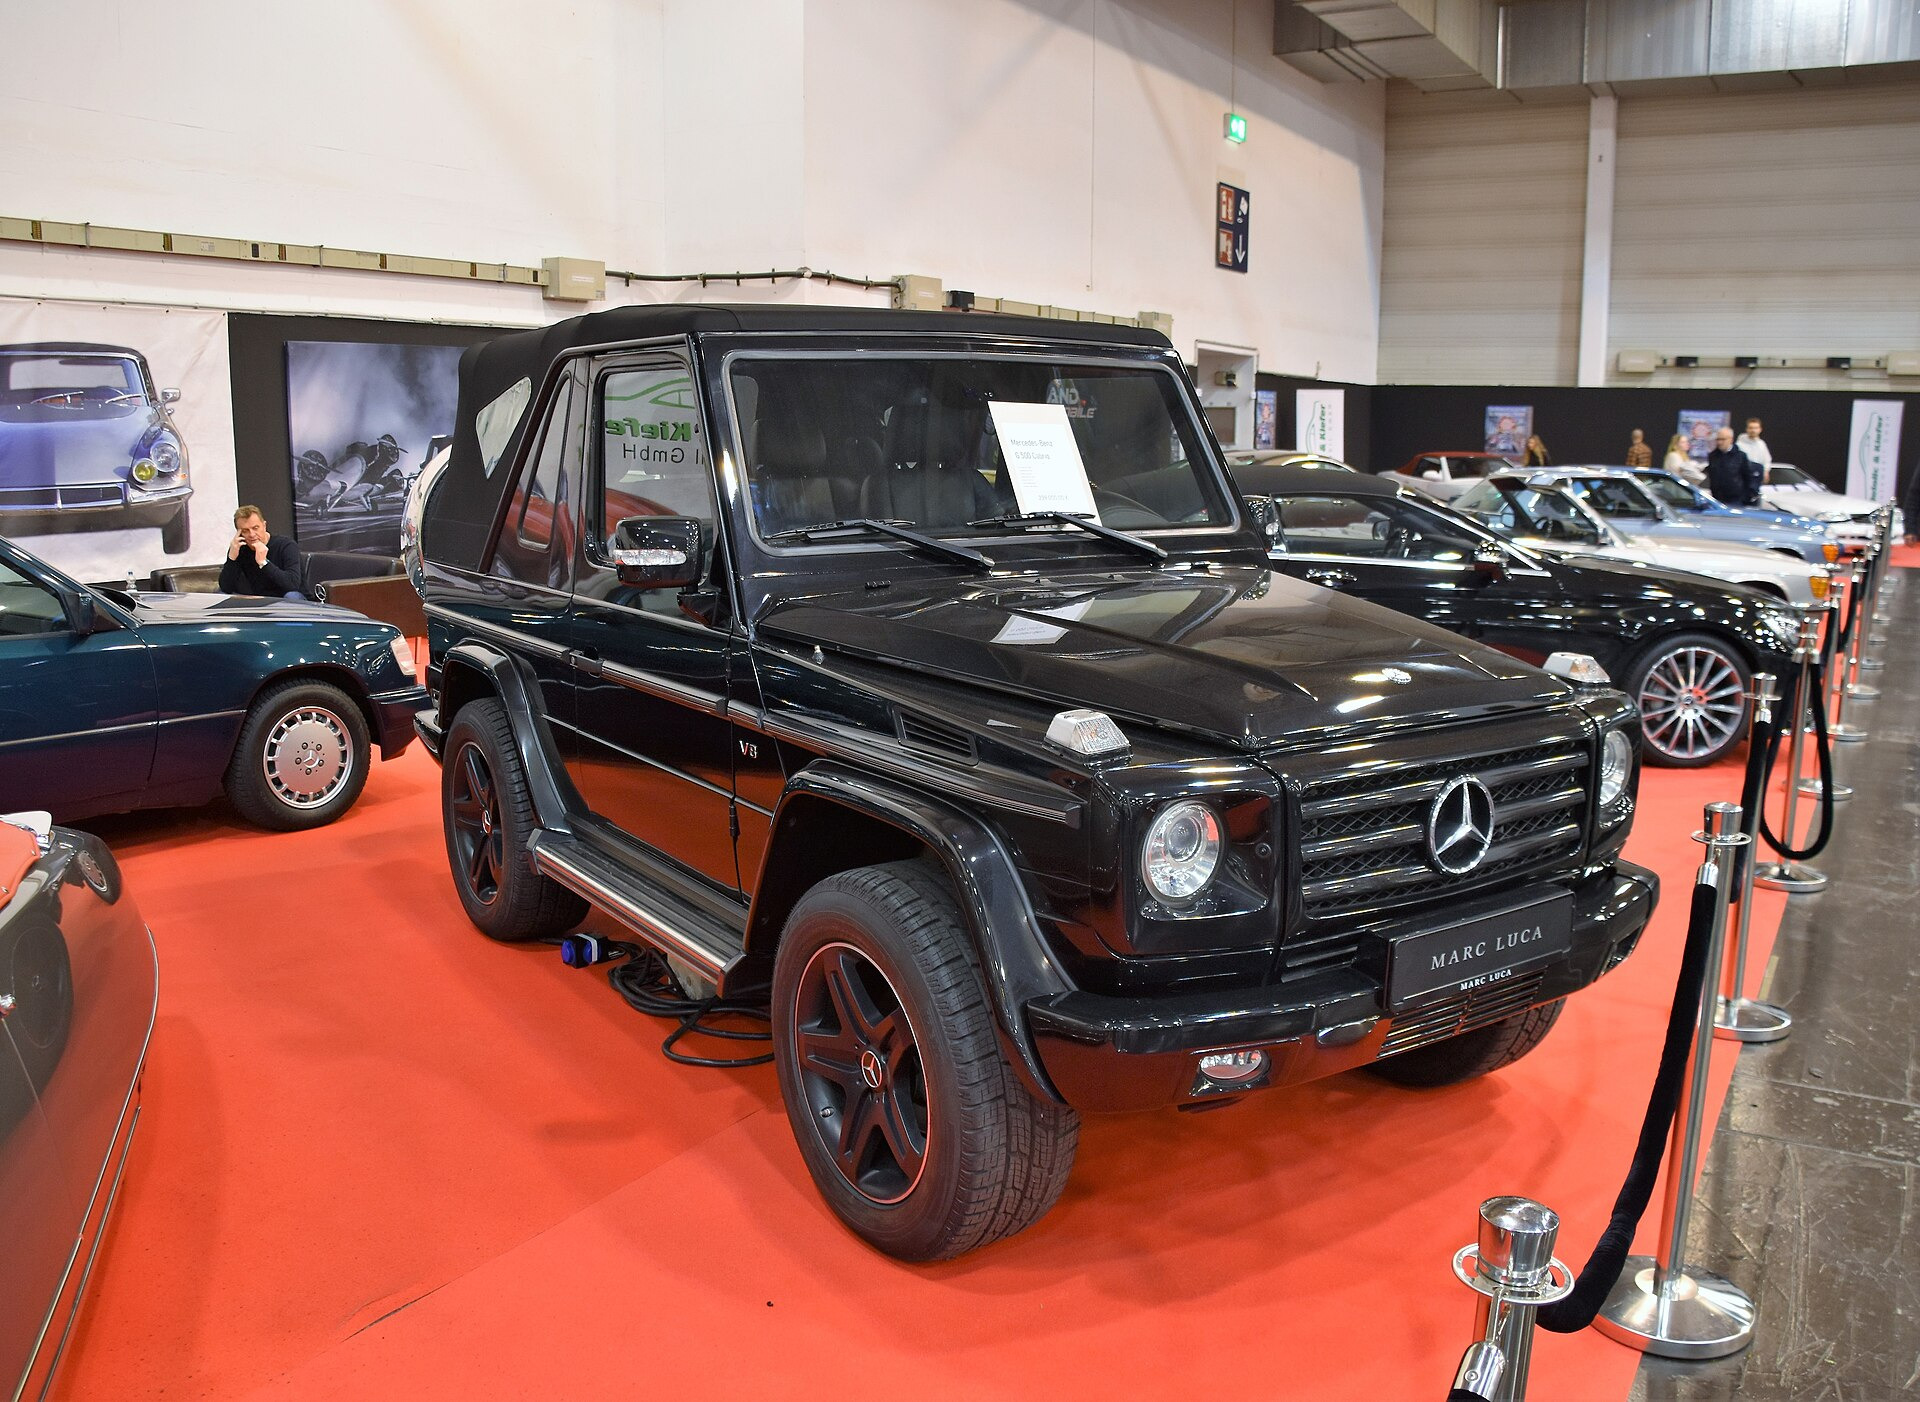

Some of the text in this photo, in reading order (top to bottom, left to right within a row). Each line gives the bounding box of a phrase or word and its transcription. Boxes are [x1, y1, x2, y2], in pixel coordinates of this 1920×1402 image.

[1430, 926, 1542, 970] MARC LUCA
[1460, 969, 1512, 991] MARC LUCA
